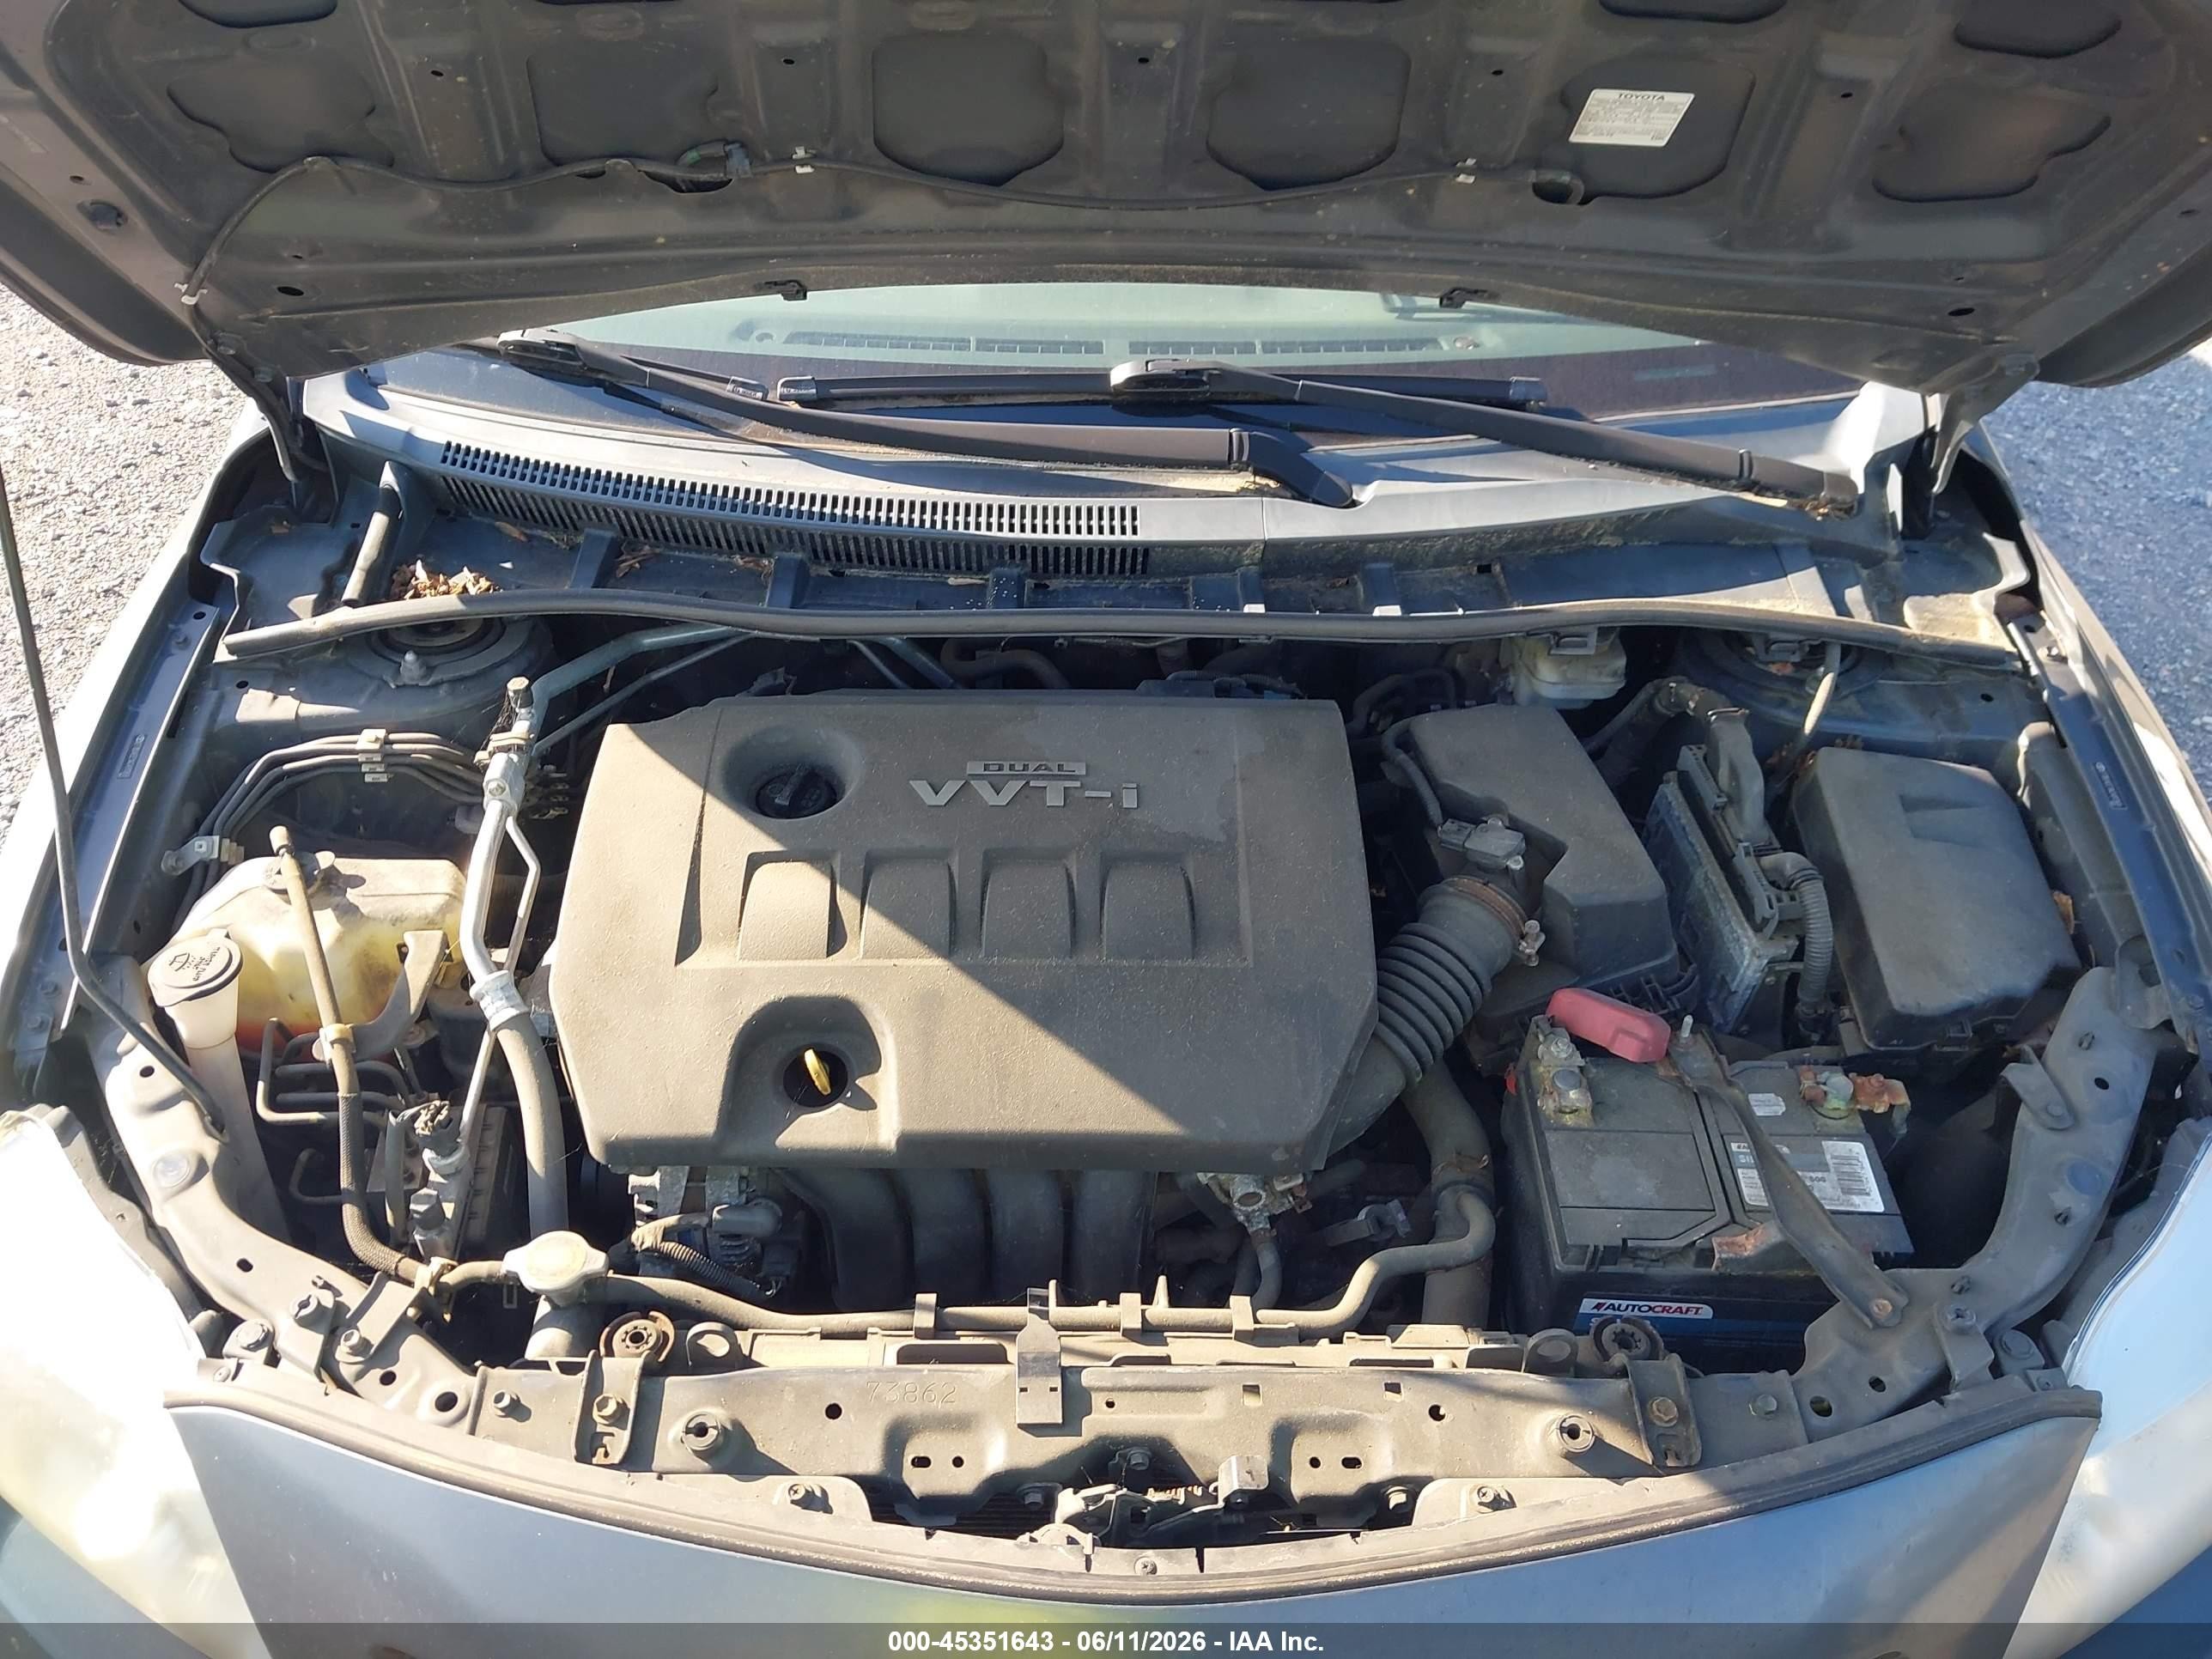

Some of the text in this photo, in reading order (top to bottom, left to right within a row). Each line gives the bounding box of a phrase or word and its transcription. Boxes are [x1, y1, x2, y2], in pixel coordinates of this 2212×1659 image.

[1618, 93, 1665, 101] TOYOTA
[983, 763, 1076, 772] DUAL
[908, 779, 1138, 808] VVT-i
[1602, 1302, 1704, 1316] AUTOCRAFT
[866, 1381, 957, 1404] 73862
